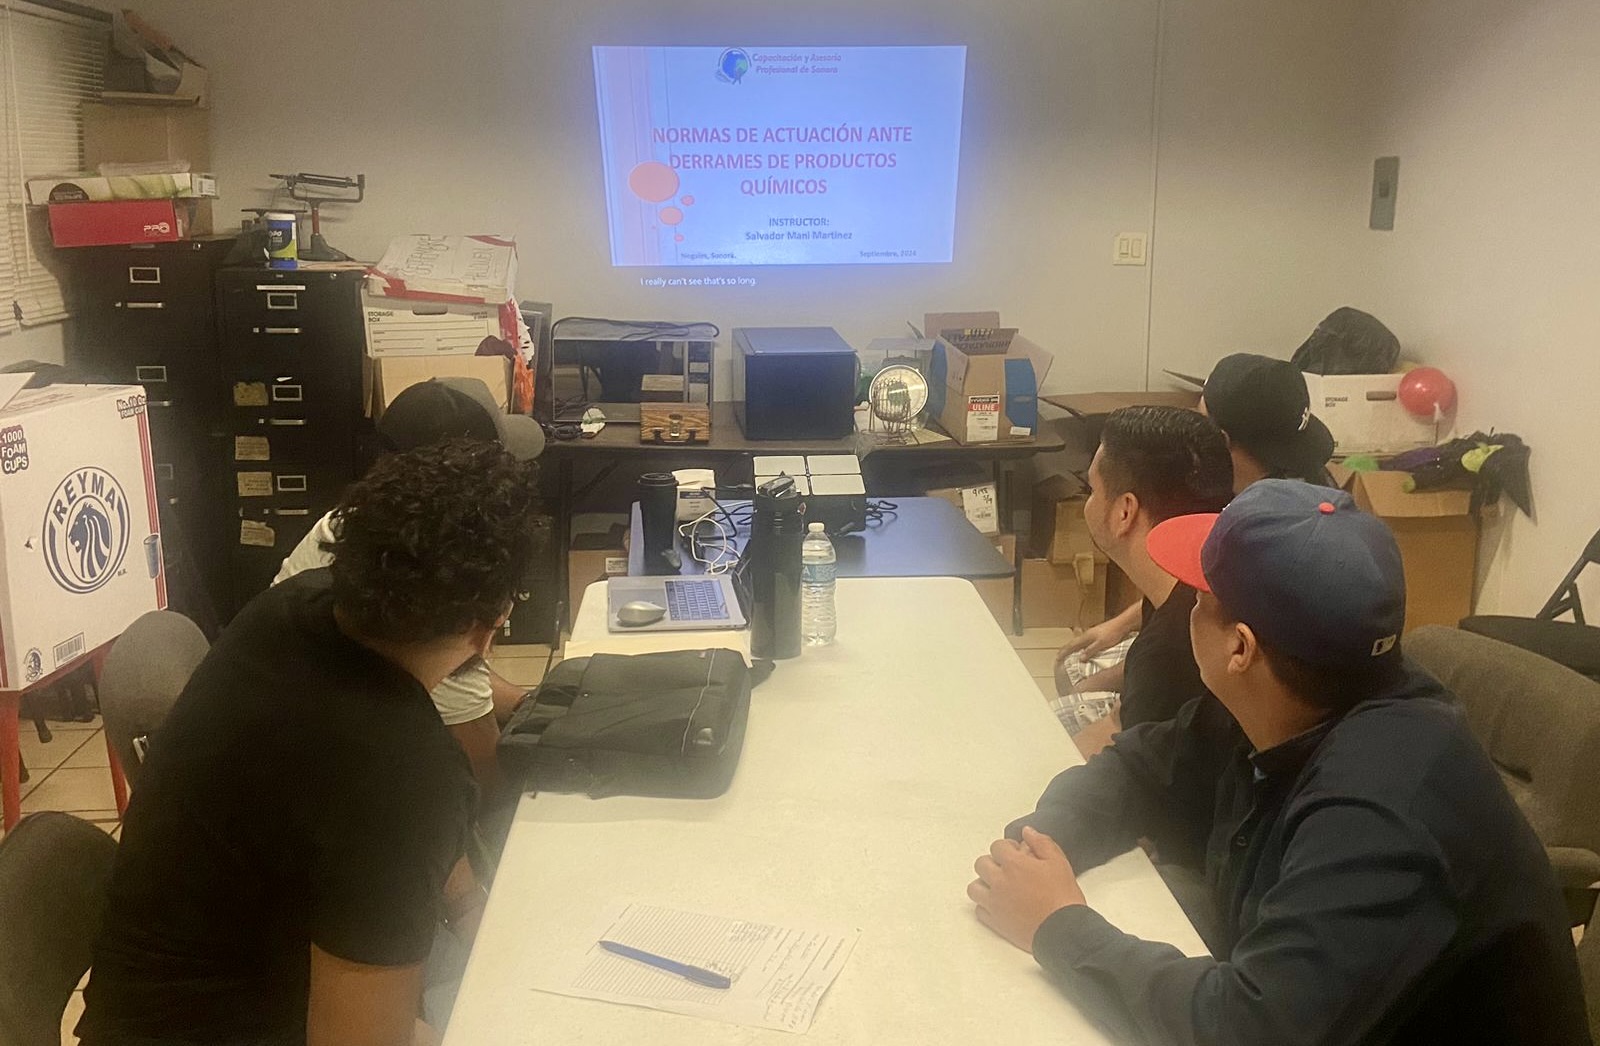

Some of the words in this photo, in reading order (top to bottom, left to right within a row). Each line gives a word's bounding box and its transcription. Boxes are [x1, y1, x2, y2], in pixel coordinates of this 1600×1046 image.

[804, 54, 809, 63] y
[800, 65, 809, 74] de
[811, 65, 838, 74] Sonora
[652, 127, 732, 143] NORMAS
[736, 127, 758, 143] DE
[763, 122, 863, 142] ACTUACIÓN
[867, 126, 913, 142] ANTE
[670, 153, 763, 169] DERRAMES
[768, 153, 790, 169] DE
[794, 153, 897, 169] PRODUCTOS
[740, 175, 828, 196] QUÍMICOS
[769, 217, 830, 227] INSTRUCTOR:
[745, 231, 785, 241] Salvador
[645, 277, 667, 288] really
[668, 277, 688, 286] can't
[703, 277, 726, 286] that's
[727, 278, 737, 286] so
[738, 277, 756, 287] long
[972, 403, 996, 411] ULINE
[2, 429, 23, 444] 1000
[1, 442, 27, 458] FOAM
[4, 456, 28, 472] CUPS
[53, 471, 116, 525] REYMA
